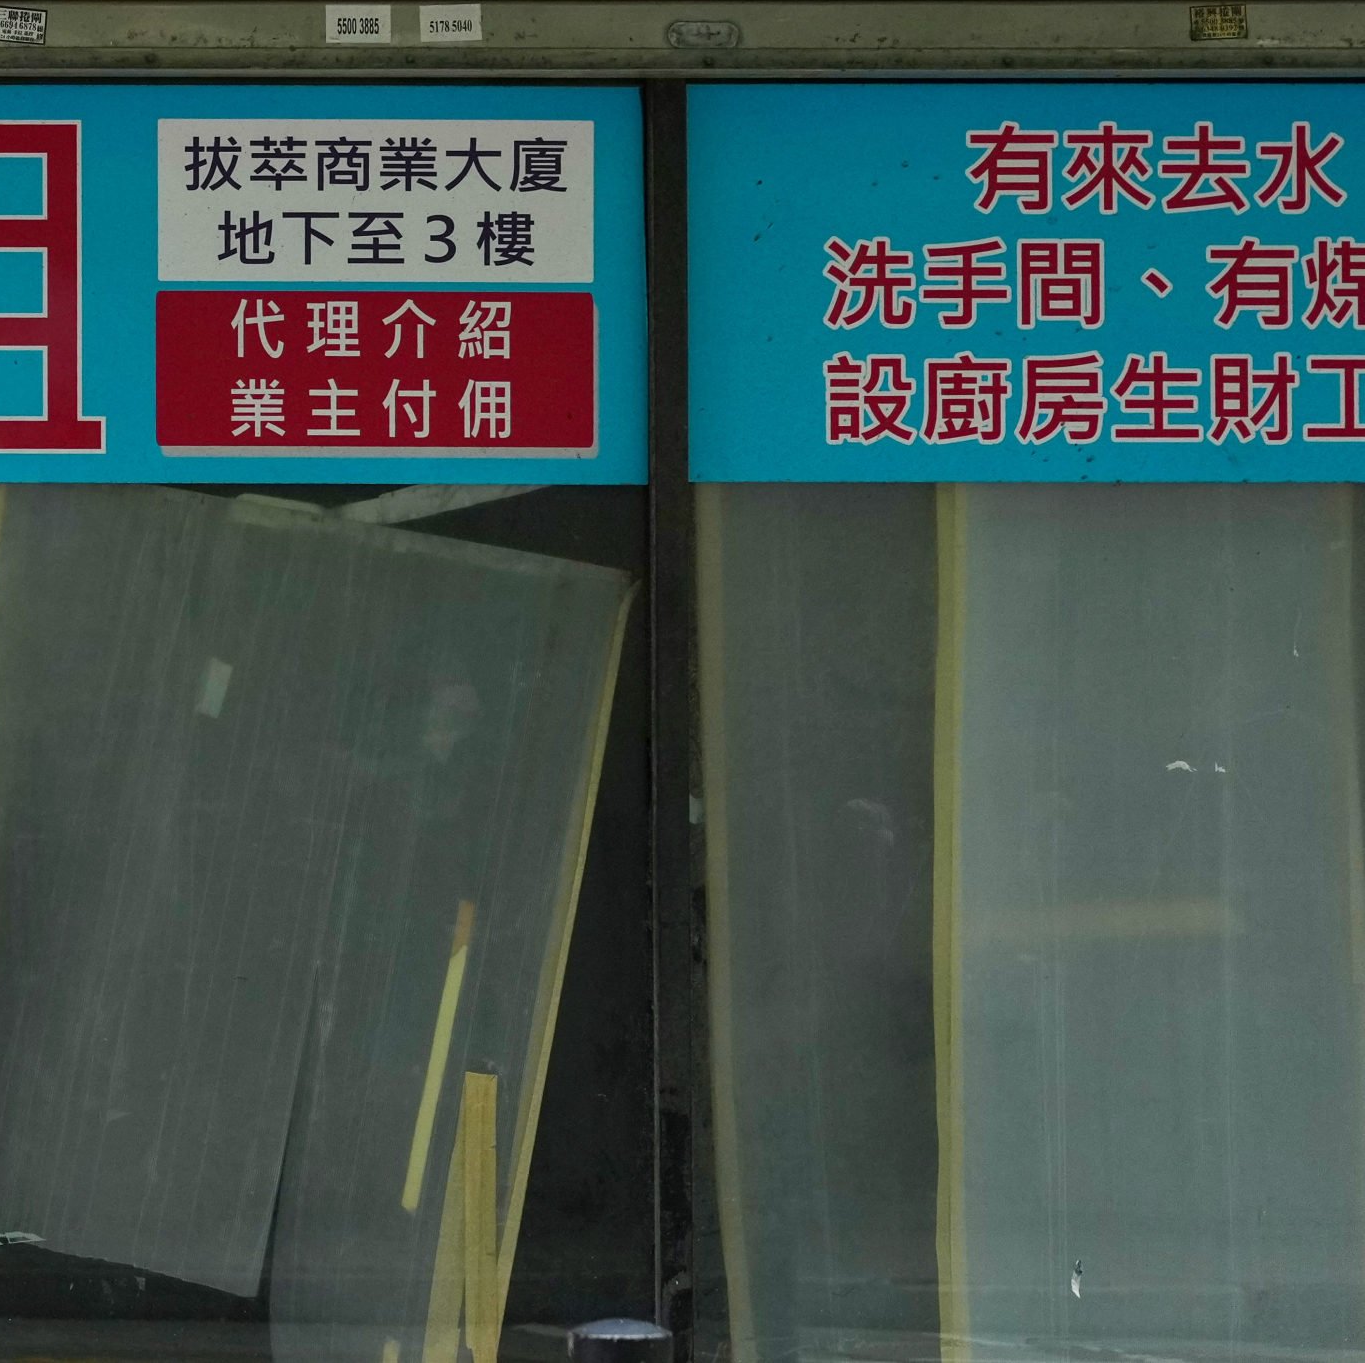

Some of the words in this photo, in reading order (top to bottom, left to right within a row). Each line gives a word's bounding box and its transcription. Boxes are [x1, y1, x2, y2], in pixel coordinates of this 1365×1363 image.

[338, 18, 356, 34] 5500
[360, 18, 379, 34] 3885
[430, 21, 449, 33] 5178
[452, 20, 472, 32] 5040
[184, 136, 569, 194] 拔萃商業大廈
[965, 120, 1346, 215] 有來去水
[230, 298, 512, 361] 代理介紹
[230, 378, 512, 440] 業主付佣
